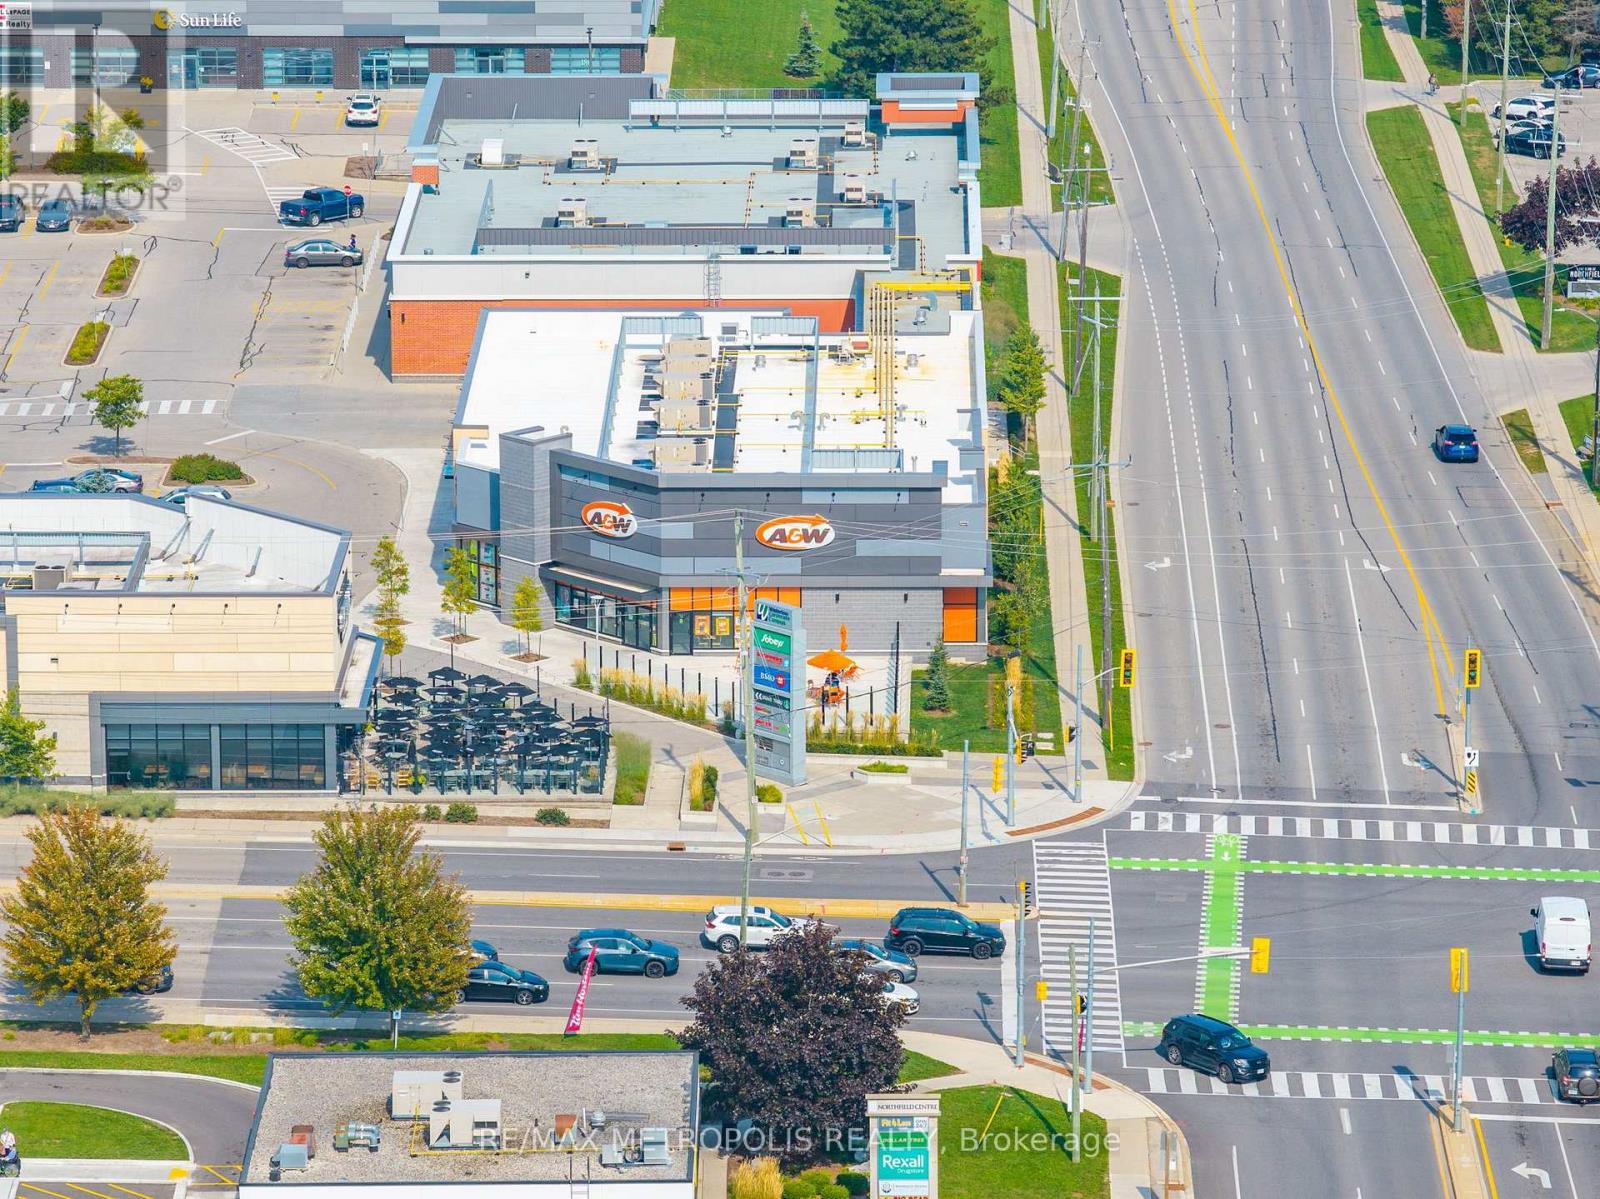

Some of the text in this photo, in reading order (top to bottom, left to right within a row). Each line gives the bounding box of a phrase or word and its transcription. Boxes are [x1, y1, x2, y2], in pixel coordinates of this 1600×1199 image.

[6, 20, 31, 29] Realty
[180, 11, 242, 27] Sun Life
[1570, 270, 1600, 278] NORTHFIEL
[590, 511, 633, 534] A&W
[767, 527, 831, 544] A&W
[882, 1154, 924, 1169] Rexall
